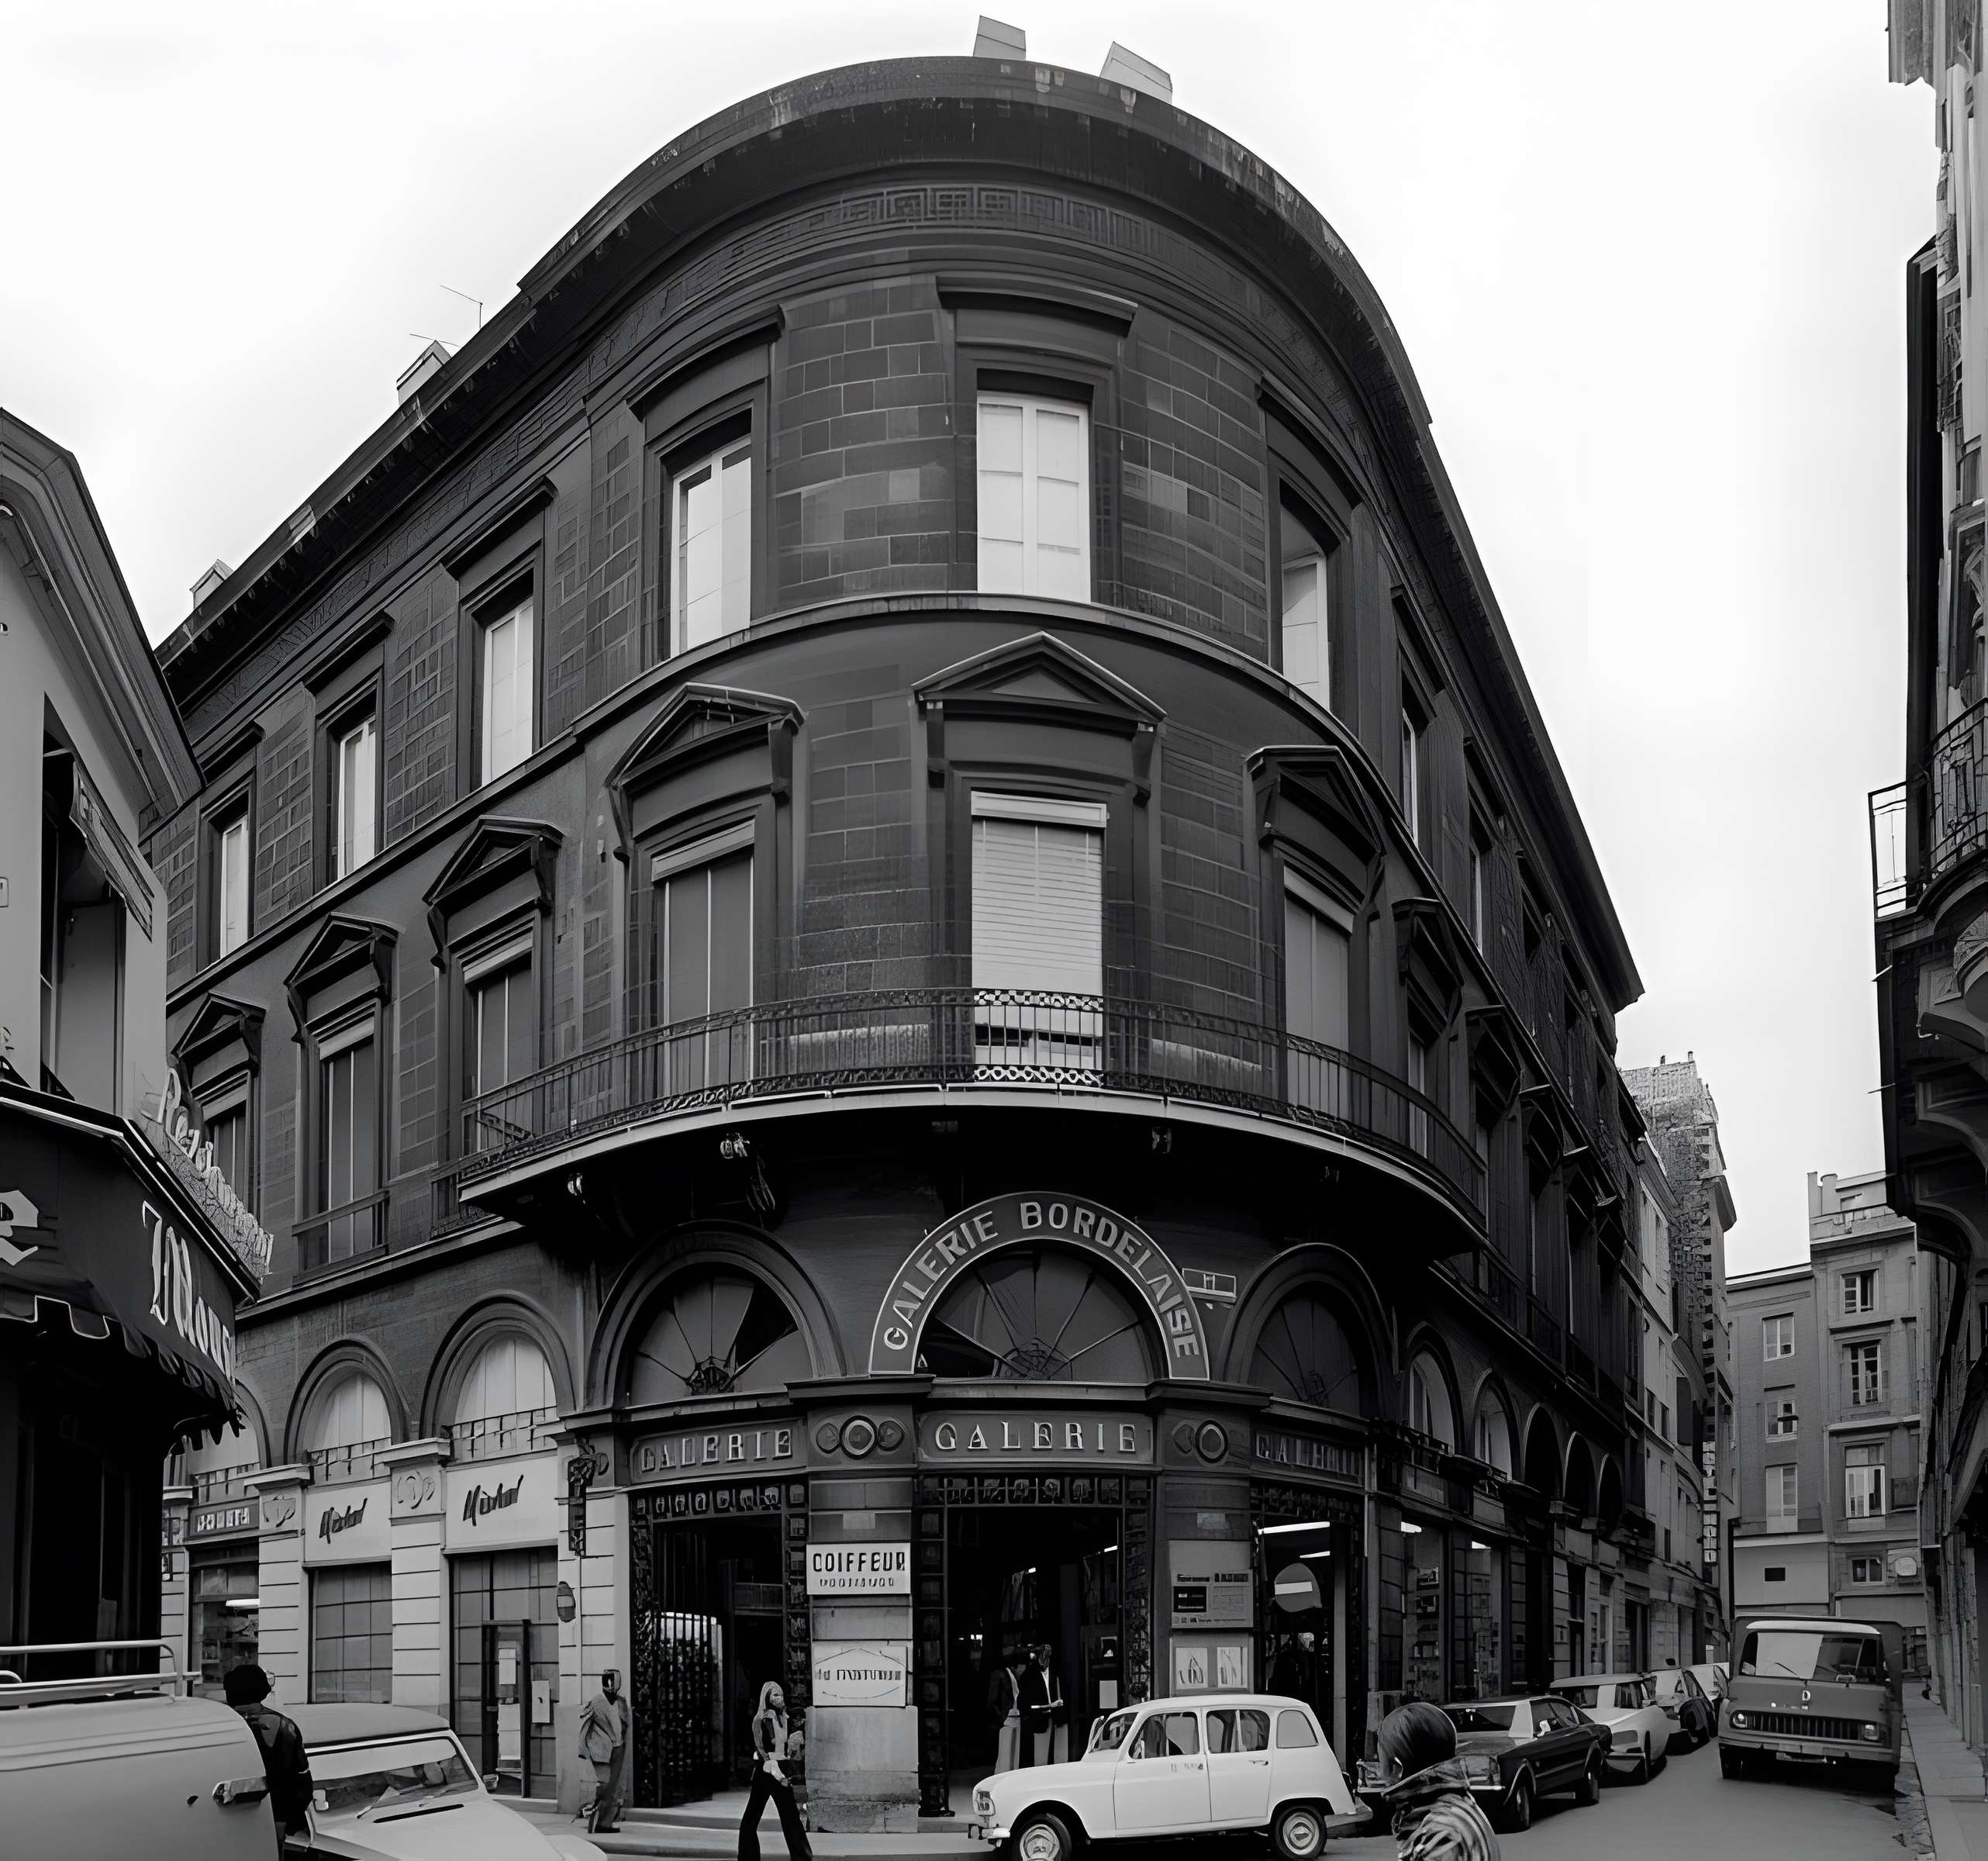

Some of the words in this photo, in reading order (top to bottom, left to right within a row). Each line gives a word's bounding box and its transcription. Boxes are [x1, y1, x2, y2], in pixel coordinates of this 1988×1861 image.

[883, 1210, 999, 1351] GALERIE
[1019, 1201, 1202, 1359] BORDELAISE
[935, 1421, 1136, 1452] GALERIE
[813, 1552, 906, 1573] COIFFEUR
